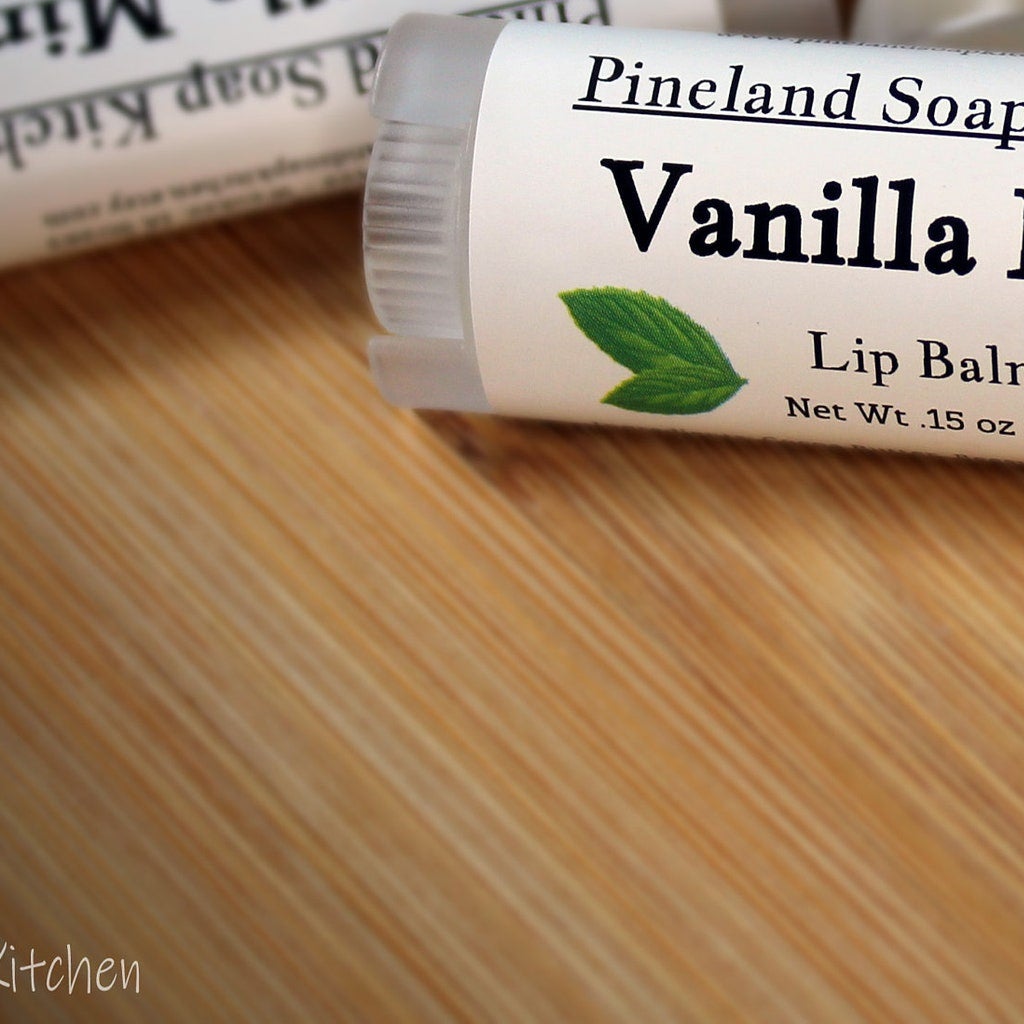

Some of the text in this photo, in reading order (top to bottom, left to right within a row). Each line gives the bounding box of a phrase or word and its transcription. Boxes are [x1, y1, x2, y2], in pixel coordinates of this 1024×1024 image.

[176, 49, 329, 114] Soap
[578, 54, 862, 122] Pineland
[600, 158, 977, 276] Vanilla
[808, 330, 899, 387] Lip
[785, 395, 847, 421] Net
[854, 401, 909, 427] Wt
[921, 408, 965, 432] .15
[976, 417, 1016, 436] oz
